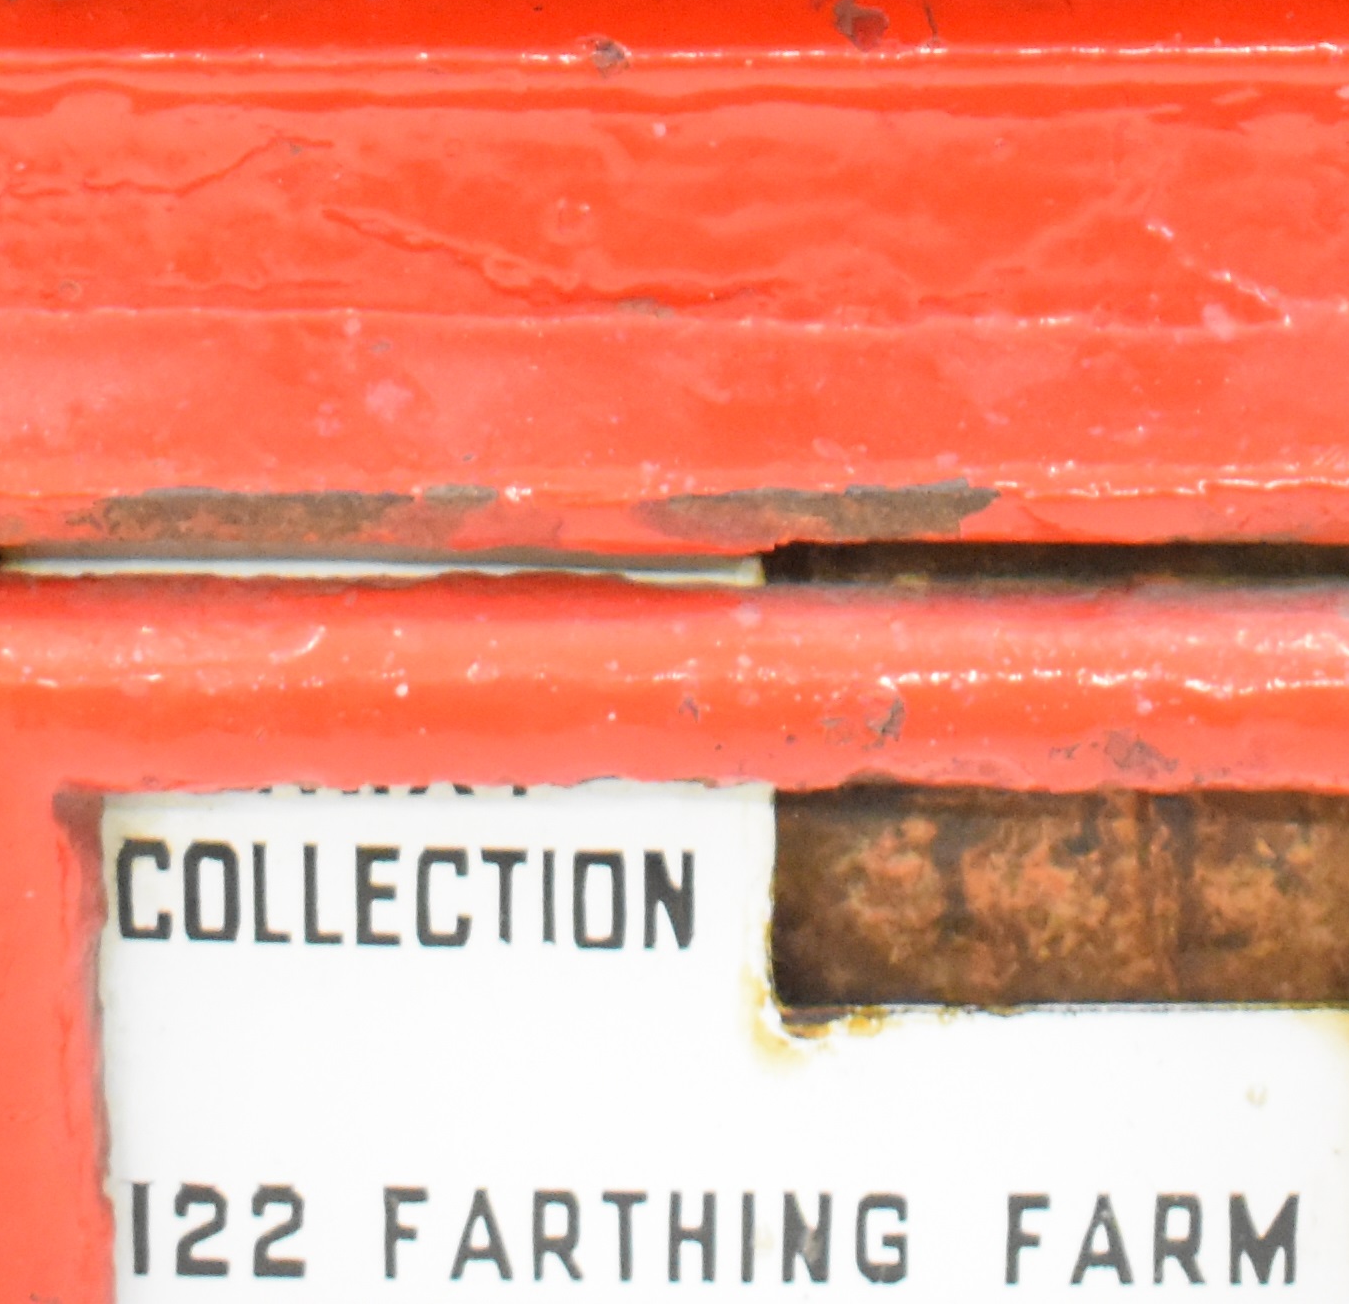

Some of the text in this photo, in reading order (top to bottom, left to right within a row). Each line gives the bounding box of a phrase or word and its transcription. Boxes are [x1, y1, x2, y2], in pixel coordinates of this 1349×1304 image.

[114, 836, 696, 950] COLLECTION
[129, 1181, 1300, 1286] 122 FARTHING FARM
